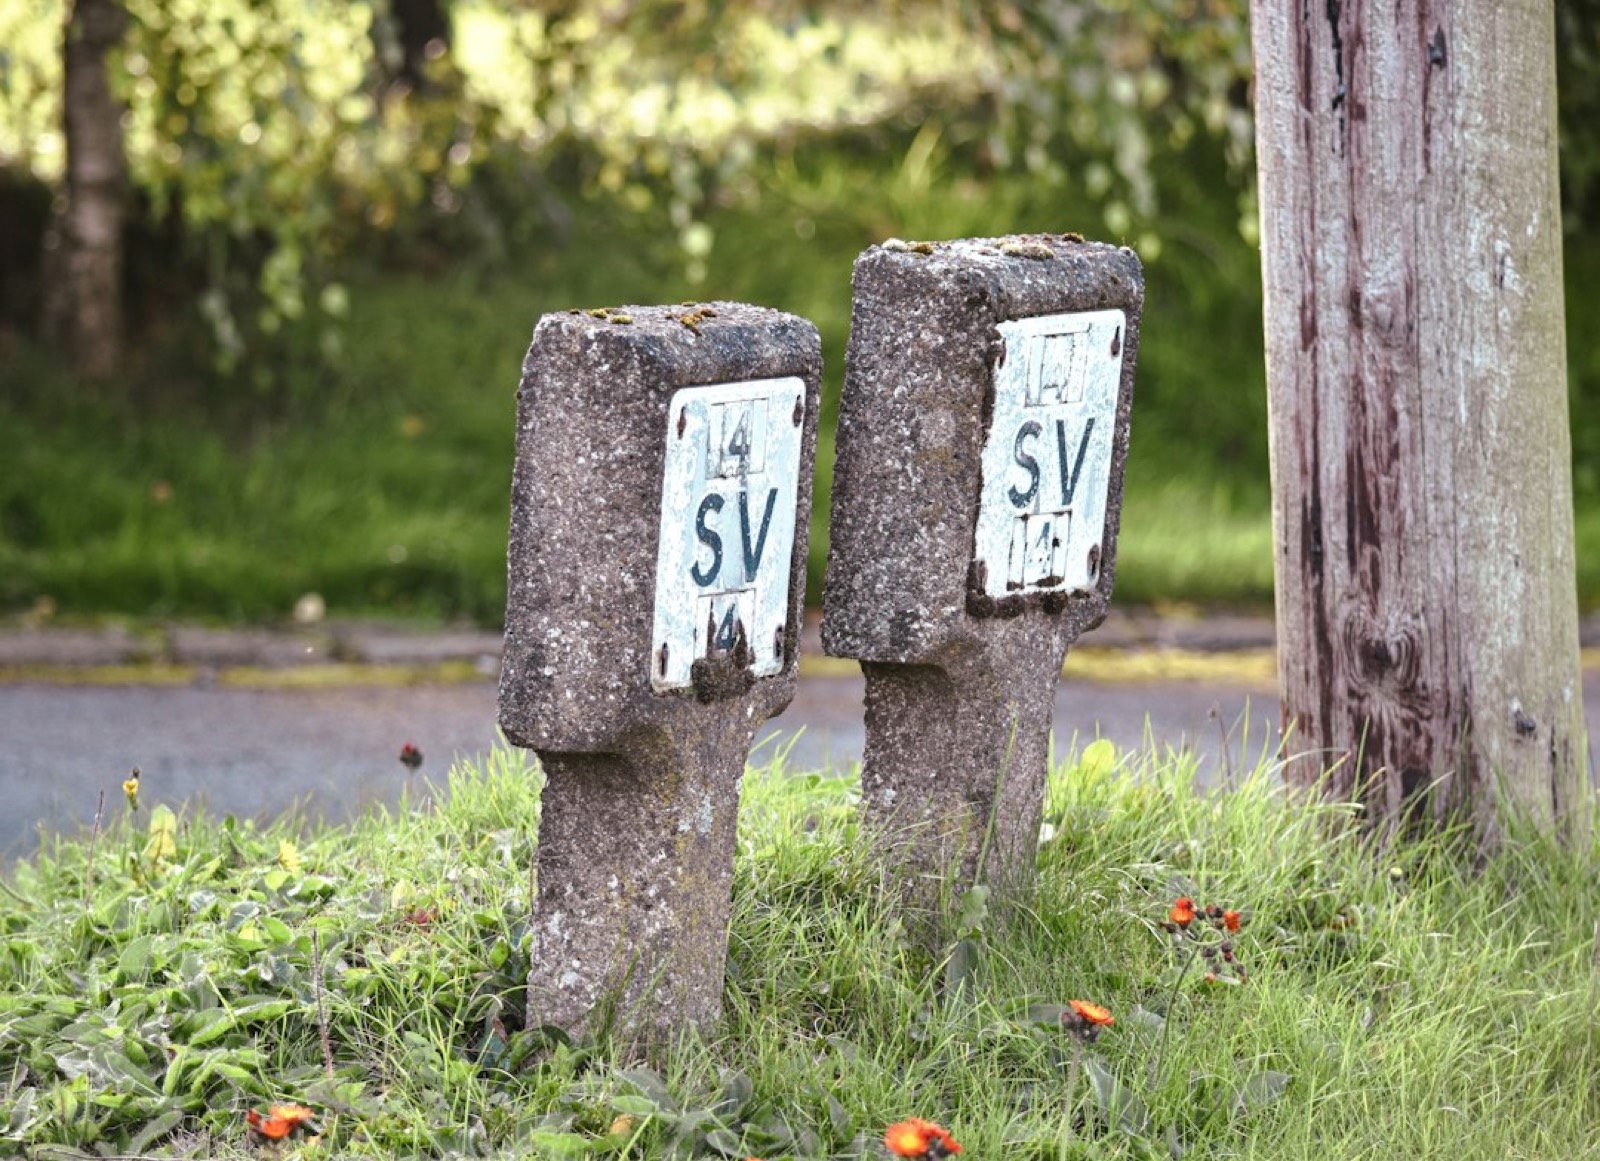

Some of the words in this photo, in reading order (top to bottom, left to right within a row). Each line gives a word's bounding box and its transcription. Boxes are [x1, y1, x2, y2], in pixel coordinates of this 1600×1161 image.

[728, 410, 749, 464] 4
[1007, 417, 1096, 509] SV
[690, 487, 779, 588] SV
[716, 603, 740, 652] 4
